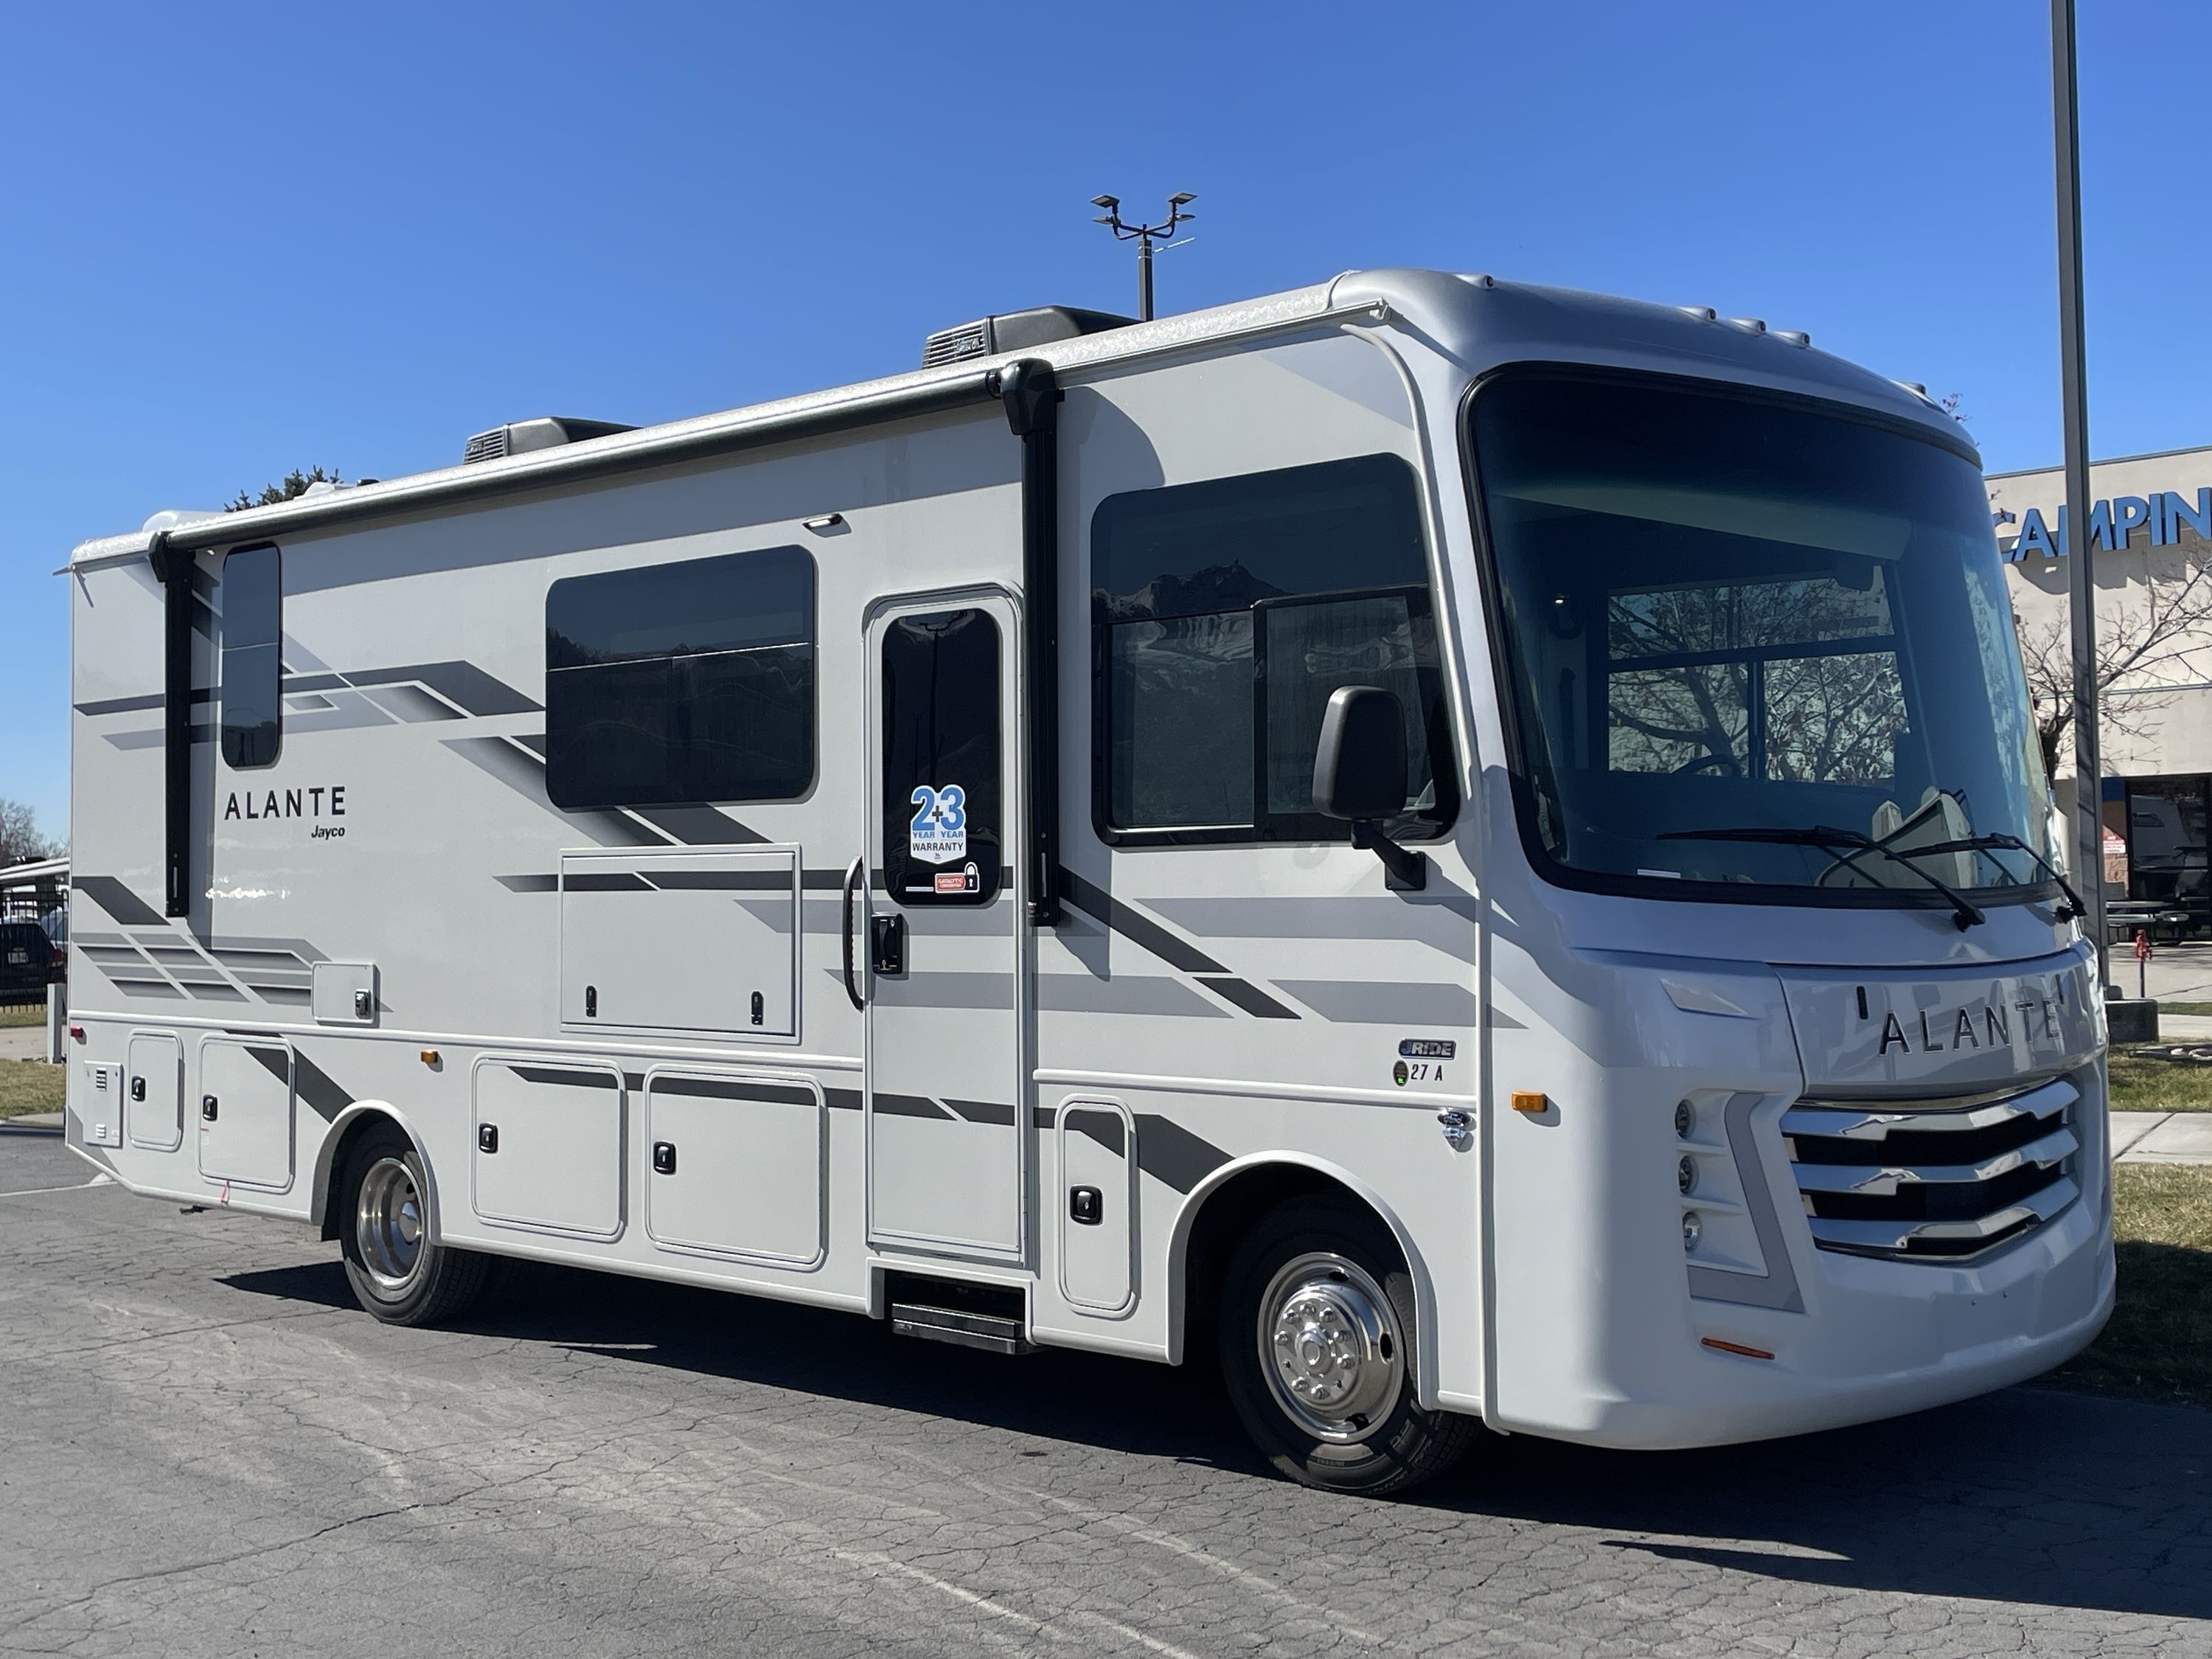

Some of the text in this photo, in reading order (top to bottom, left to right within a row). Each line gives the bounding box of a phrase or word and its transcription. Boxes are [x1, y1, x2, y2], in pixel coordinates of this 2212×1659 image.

[224, 786, 345, 820] ALANTE
[311, 825, 345, 840] Jayco
[913, 842, 964, 851] WARRANTY
[1879, 998, 2060, 1055] ALANTE
[1411, 1064, 1443, 1081] 27 A
